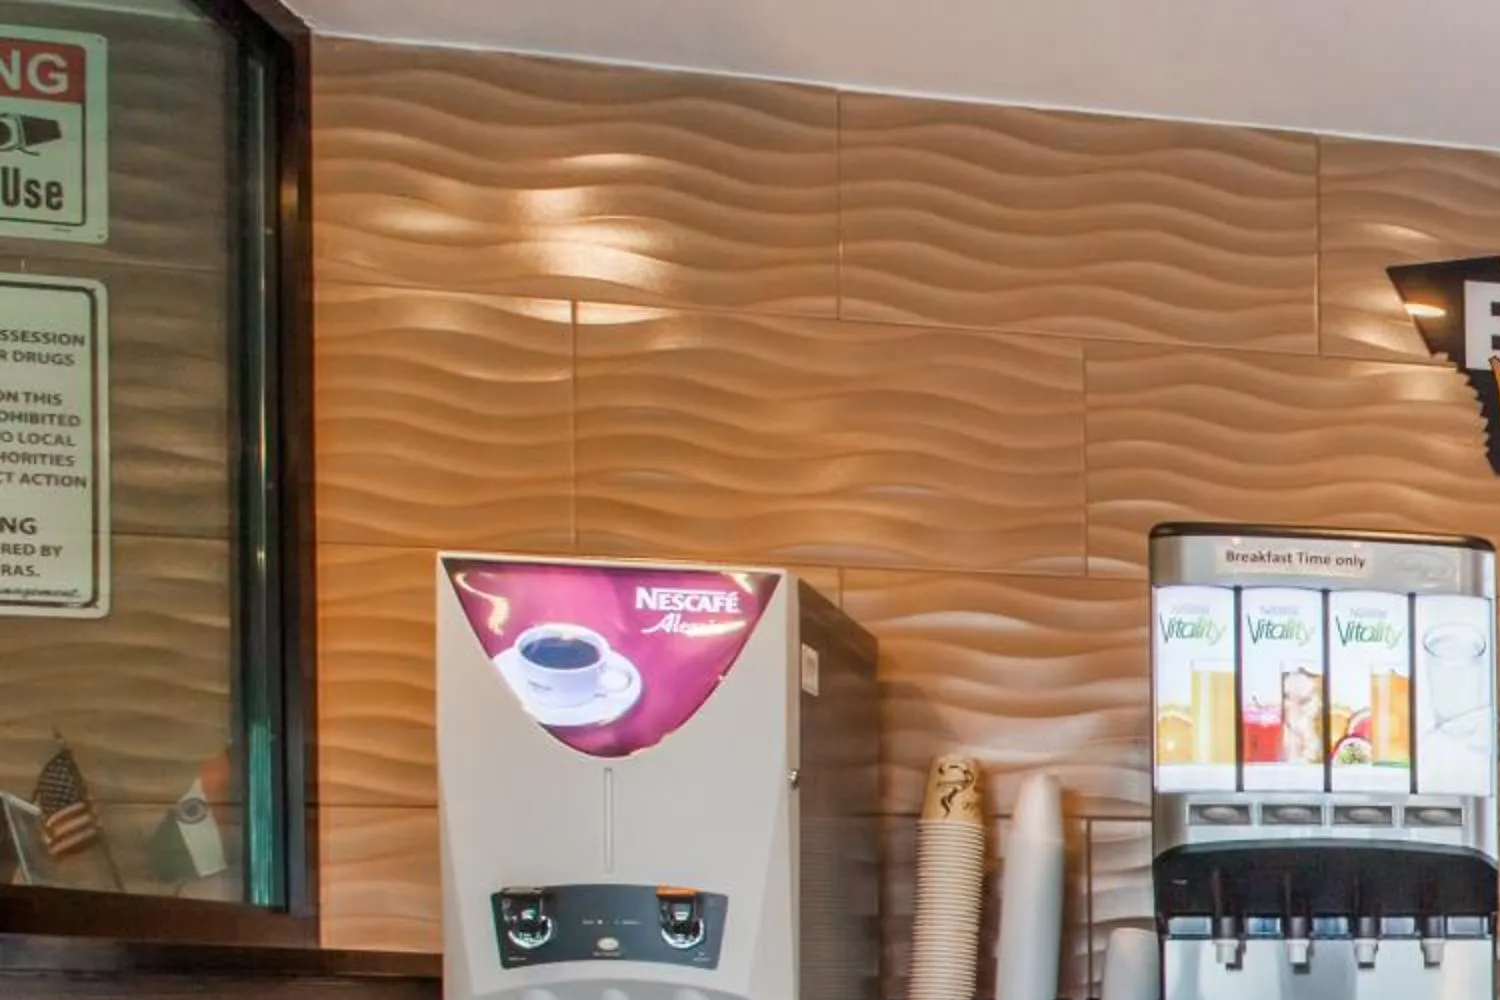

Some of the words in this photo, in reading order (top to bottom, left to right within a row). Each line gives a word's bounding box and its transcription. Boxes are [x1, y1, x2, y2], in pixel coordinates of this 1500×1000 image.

[1, 166, 63, 210] Use
[12, 350, 75, 366] DRUGS
[22, 391, 63, 406] THIS
[18, 432, 76, 447] LOCAL
[19, 473, 87, 489] ACTION
[40, 545, 63, 557] BY
[1226, 550, 1292, 564] Breakfast
[1297, 551, 1331, 566] Time
[1335, 553, 1366, 569] only
[1159, 612, 1227, 646] Vitality
[1246, 613, 1315, 647] Vitality
[1335, 615, 1404, 650] Vitality
